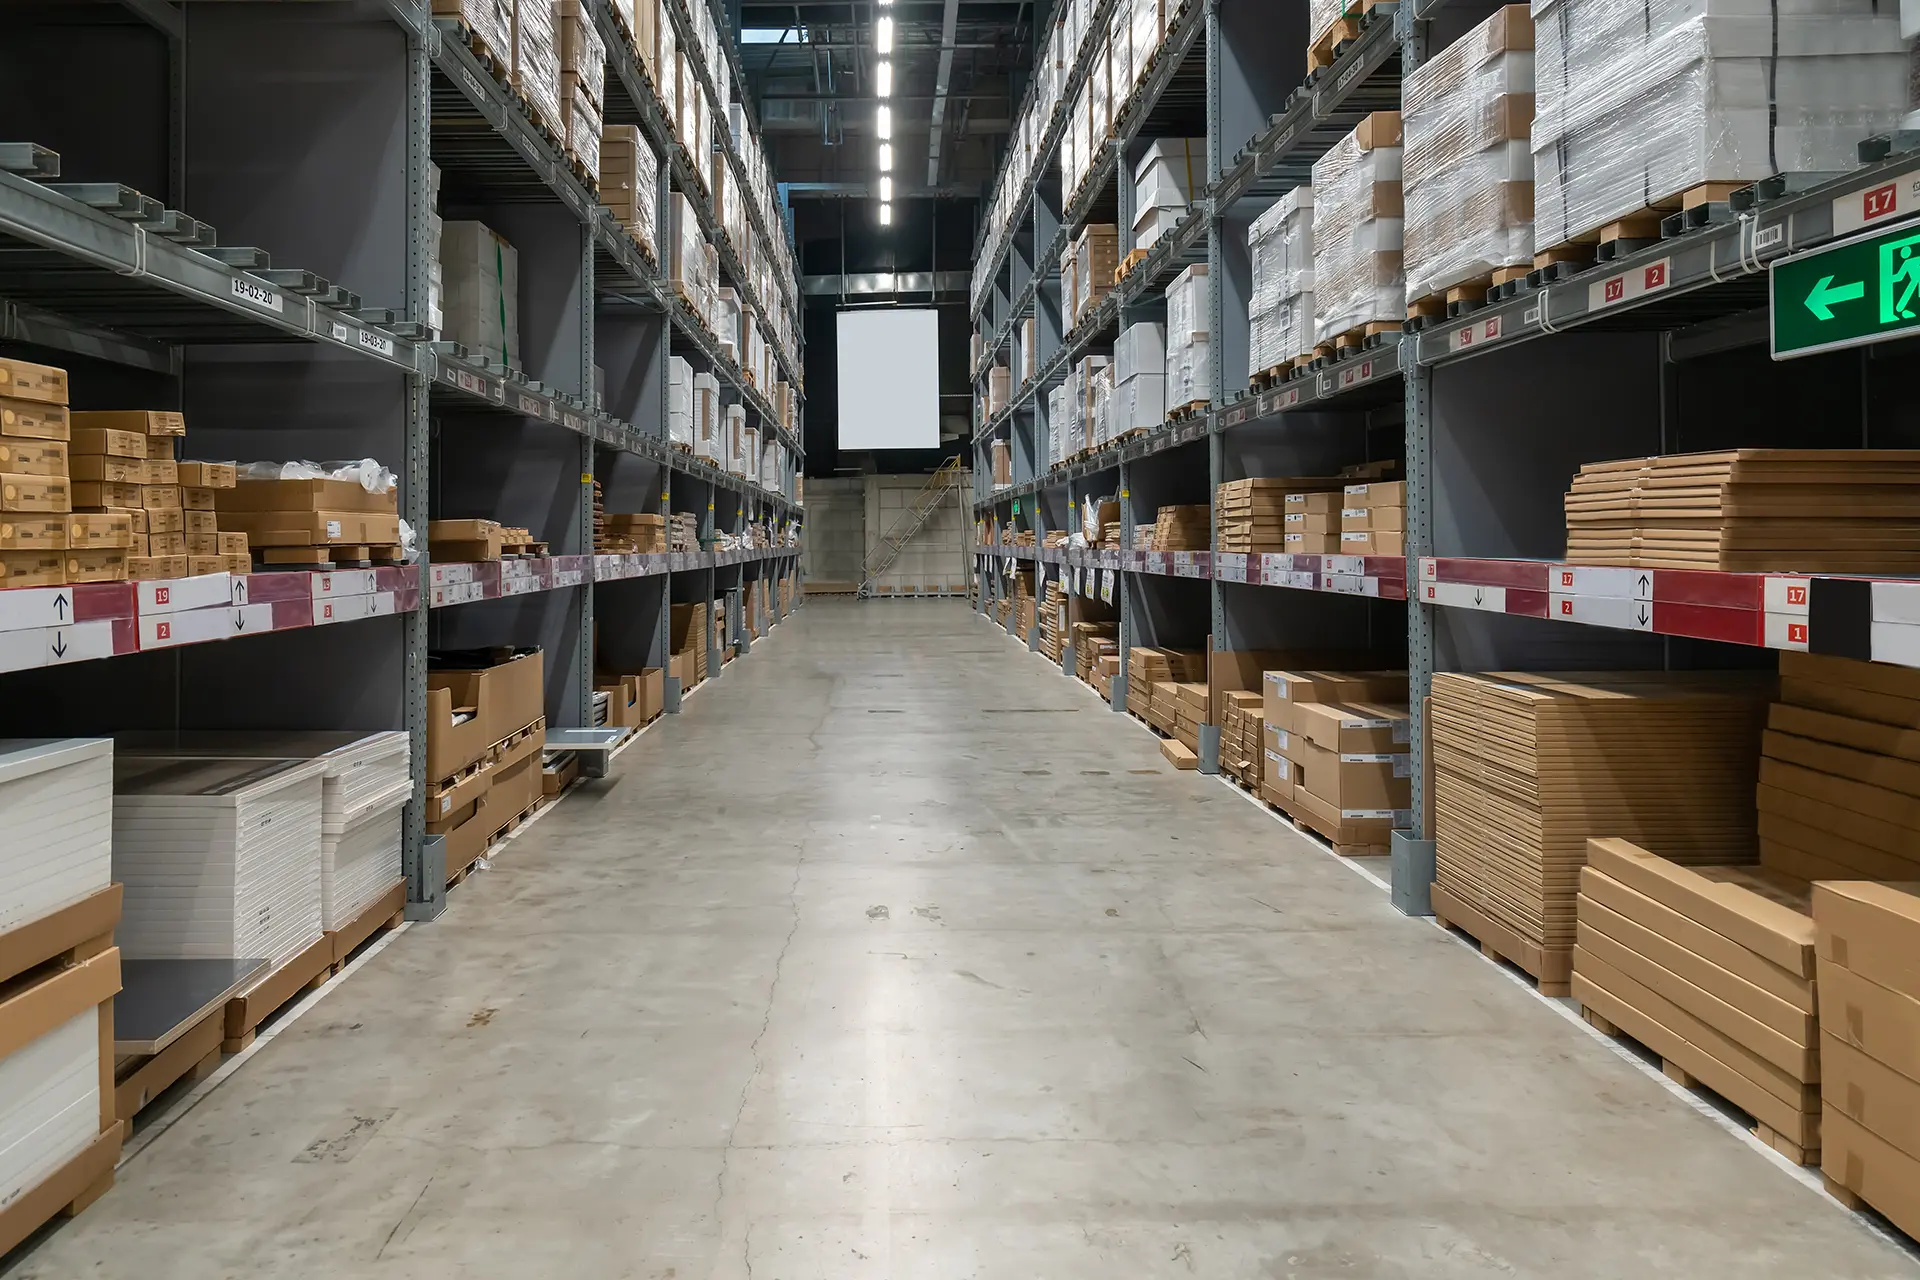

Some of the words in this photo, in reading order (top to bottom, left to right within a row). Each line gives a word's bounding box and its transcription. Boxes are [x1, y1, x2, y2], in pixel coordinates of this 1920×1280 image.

[1869, 189, 1893, 214] 17
[1608, 282, 1621, 298] 17
[1651, 269, 1659, 284] 2
[234, 279, 273, 305] 19-02-20
[361, 332, 387, 350] 19-03-20
[1461, 330, 1471, 344] 17
[1563, 573, 1572, 584] 17
[157, 590, 168, 602] 19
[1789, 589, 1804, 602] 17
[325, 607, 330, 616] 3
[1565, 603, 1570, 612] 2
[160, 626, 166, 636] 2
[1794, 627, 1802, 639] 1
